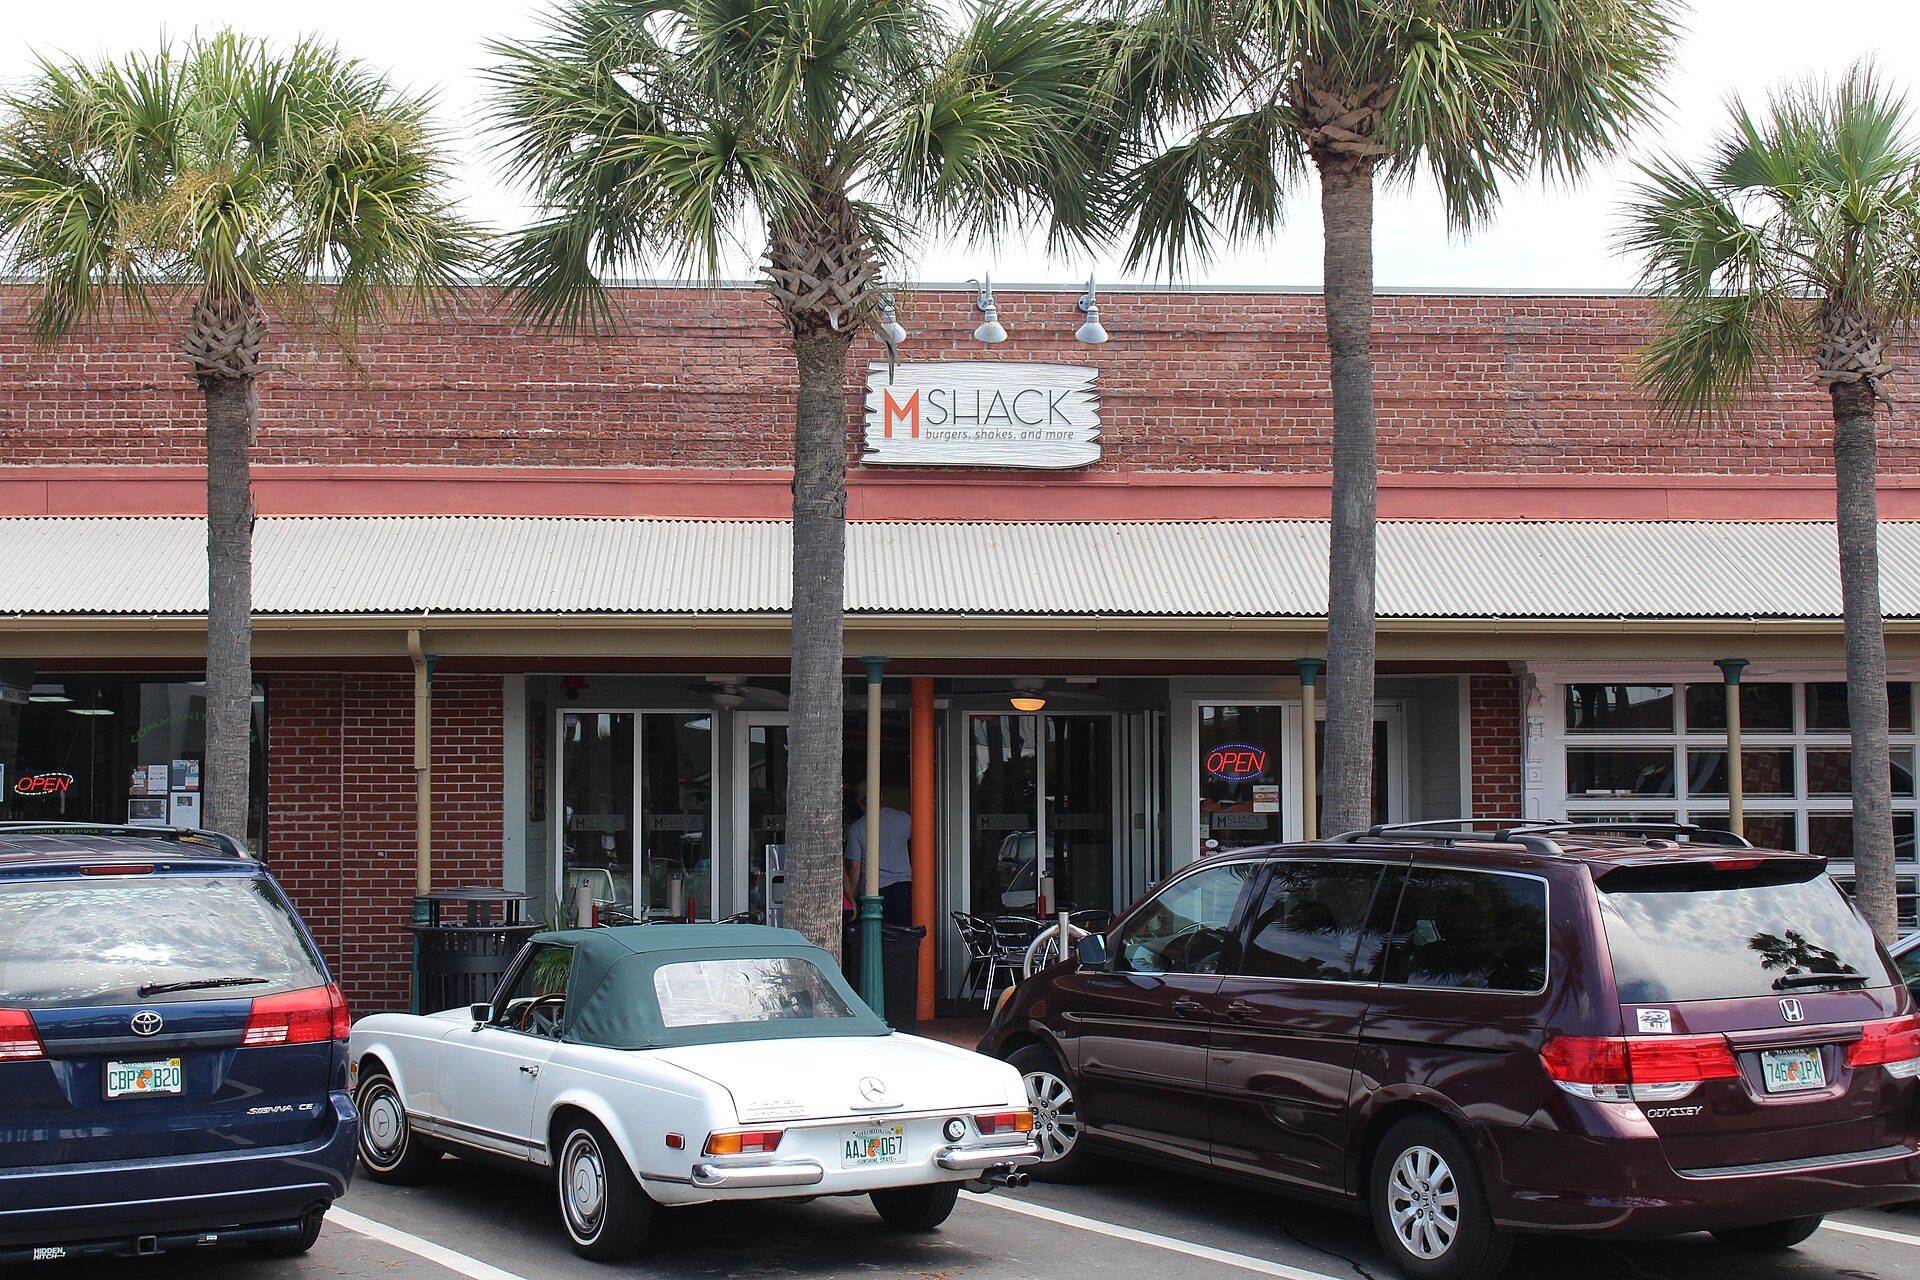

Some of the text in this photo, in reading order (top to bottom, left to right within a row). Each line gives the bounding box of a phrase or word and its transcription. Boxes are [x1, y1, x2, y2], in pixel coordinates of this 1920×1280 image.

[884, 387, 1073, 439] M SHACK
[925, 428, 1074, 442] burgers, shakes, and more
[130, 711, 206, 744] COMMUNIT
[1206, 751, 1266, 772] OPEN
[17, 776, 71, 792] OPEN
[576, 816, 585, 829] M
[654, 816, 664, 829] M
[981, 815, 990, 828] M
[1217, 814, 1262, 828] M SHACK
[1643, 1021, 1666, 1031] SJU
[1766, 1060, 1821, 1082] 746 1PX
[109, 1067, 180, 1090] CBP B20
[246, 1104, 294, 1115] SIENNA
[1647, 1105, 1704, 1118] ODYSSEY
[845, 1136, 903, 1159] AAJ D67
[33, 1253, 58, 1261] HITCH
